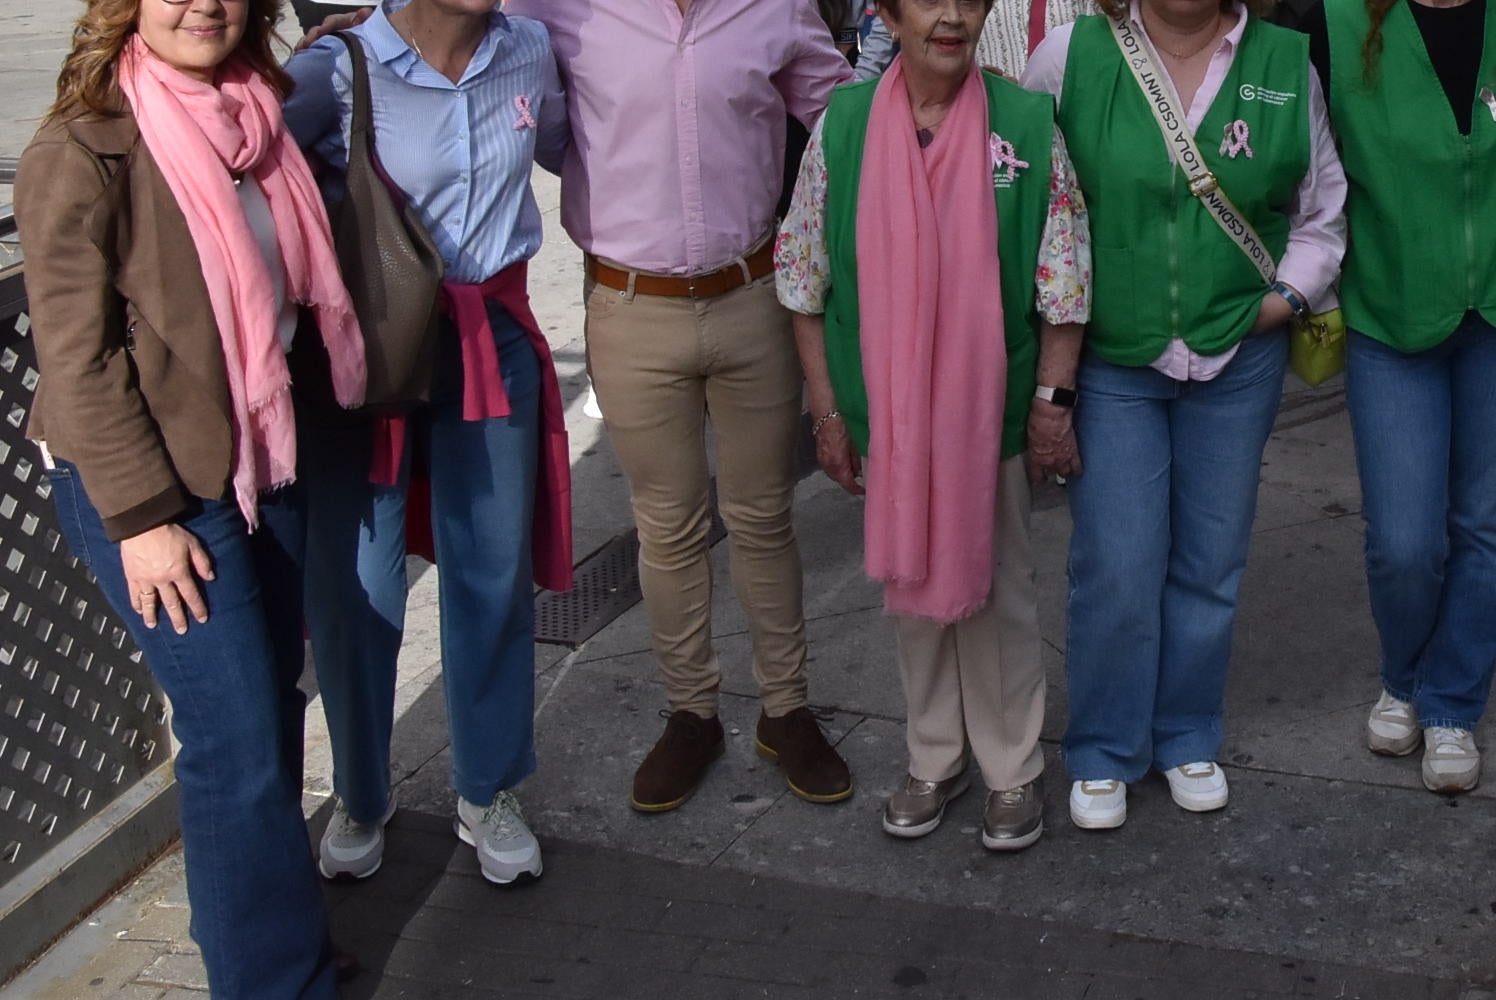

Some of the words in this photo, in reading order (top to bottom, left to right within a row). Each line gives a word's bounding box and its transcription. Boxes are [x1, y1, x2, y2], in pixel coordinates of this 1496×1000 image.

[1117, 20, 1140, 55] LOLA
[1140, 72, 1179, 131] CSDMNT
[1174, 131, 1200, 172] LOLA
[1205, 192, 1245, 236] CSDMN
[1243, 233, 1265, 264] LOLA
